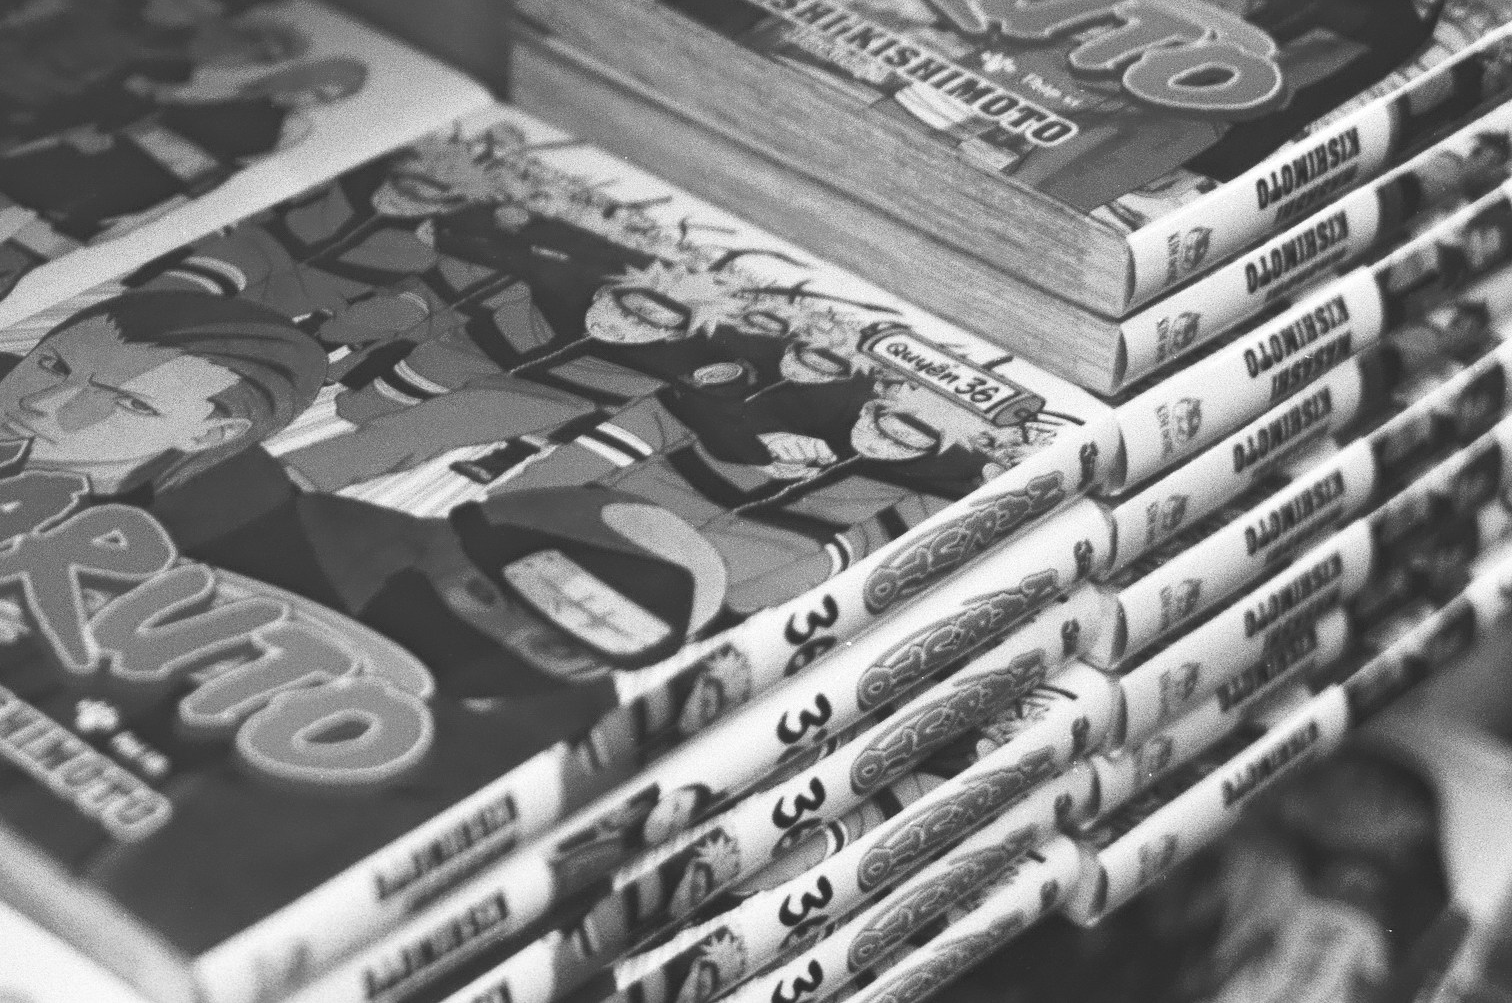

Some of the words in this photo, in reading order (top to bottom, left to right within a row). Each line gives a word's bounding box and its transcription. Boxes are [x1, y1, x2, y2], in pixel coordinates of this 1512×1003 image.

[844, 23, 1079, 148] KISHIMOTO
[1256, 125, 1360, 211] KISHIMOTO
[1244, 209, 1349, 295] KISHIMOTO
[1244, 293, 1350, 379] KISHIMOTO
[953, 376, 1000, 403] 36
[1232, 386, 1333, 474] KISHIMOTO
[1244, 469, 1345, 557] KISHIMOTO
[1243, 550, 1344, 639] KISHIMOTO
